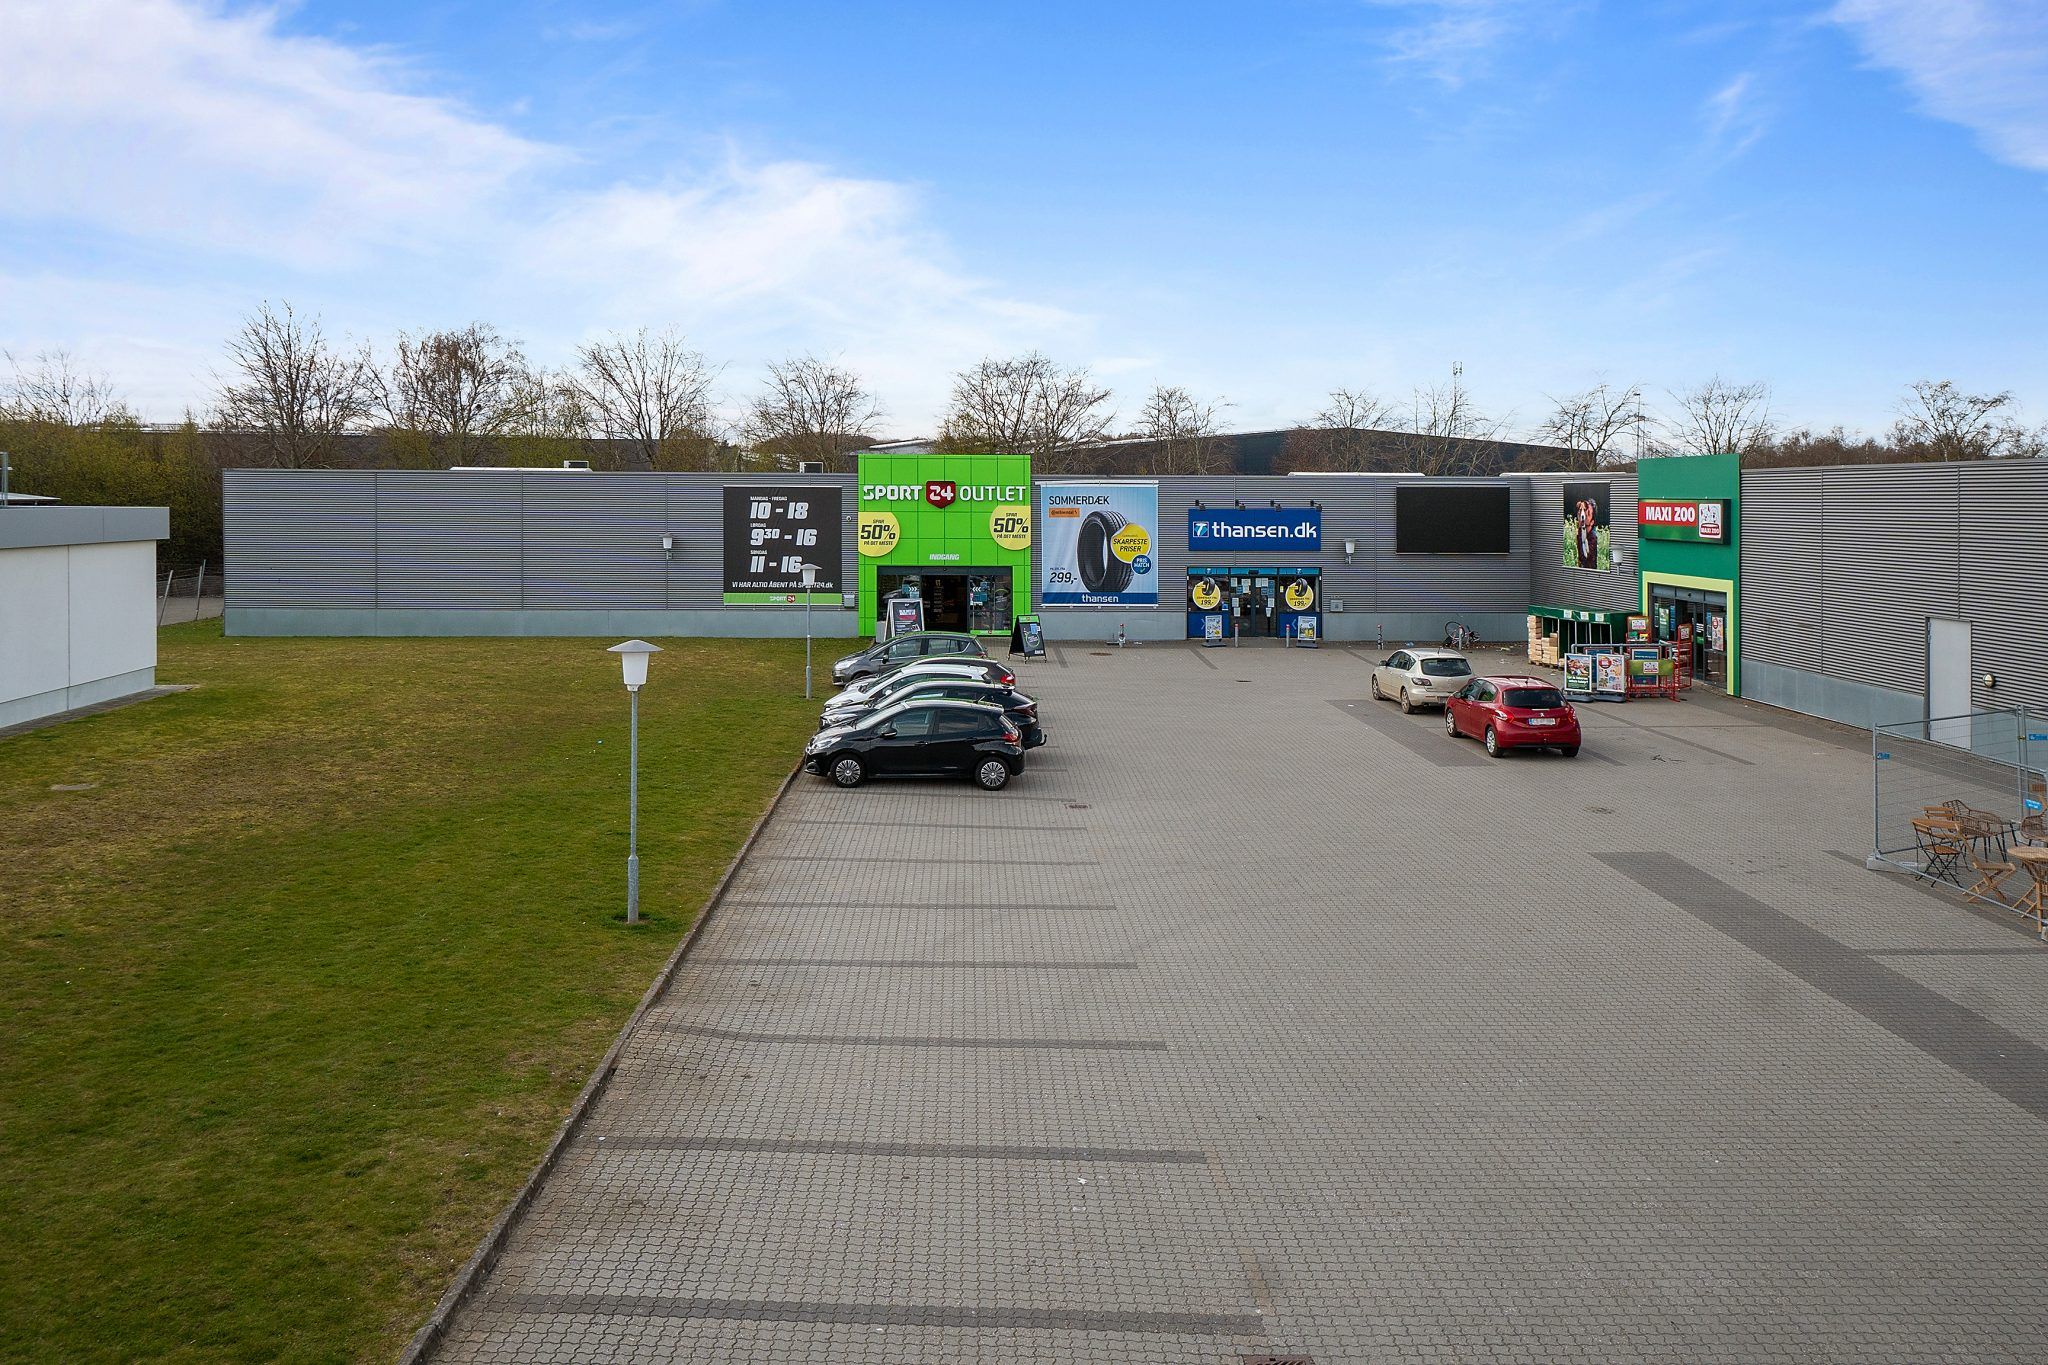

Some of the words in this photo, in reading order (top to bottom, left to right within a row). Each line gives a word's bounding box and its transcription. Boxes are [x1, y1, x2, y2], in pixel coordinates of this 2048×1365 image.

[863, 485, 922, 501] SPORT
[929, 485, 954, 501] 24
[959, 485, 1026, 501] OUTLET
[1048, 495, 1110, 505] SOMMERDÆK
[750, 501, 771, 519] 10
[787, 501, 809, 519] 18
[1645, 506, 1671, 522] MAXI
[1674, 506, 1696, 523] ZOO
[860, 524, 896, 540] 50%
[993, 518, 1029, 534] 50%
[1212, 521, 1317, 538] thansen.dk
[1700, 526, 1711, 535] MAXI
[1711, 527, 1720, 535] ZOO
[796, 528, 818, 546] 16
[750, 556, 765, 573] 11
[781, 556, 803, 573] 16
[929, 553, 960, 561] INDGANG
[768, 580, 789, 588] ÅBENT
[789, 580, 797, 588] PÅ
[1049, 572, 1078, 585] 299,-
[1081, 593, 1119, 603] thansen
